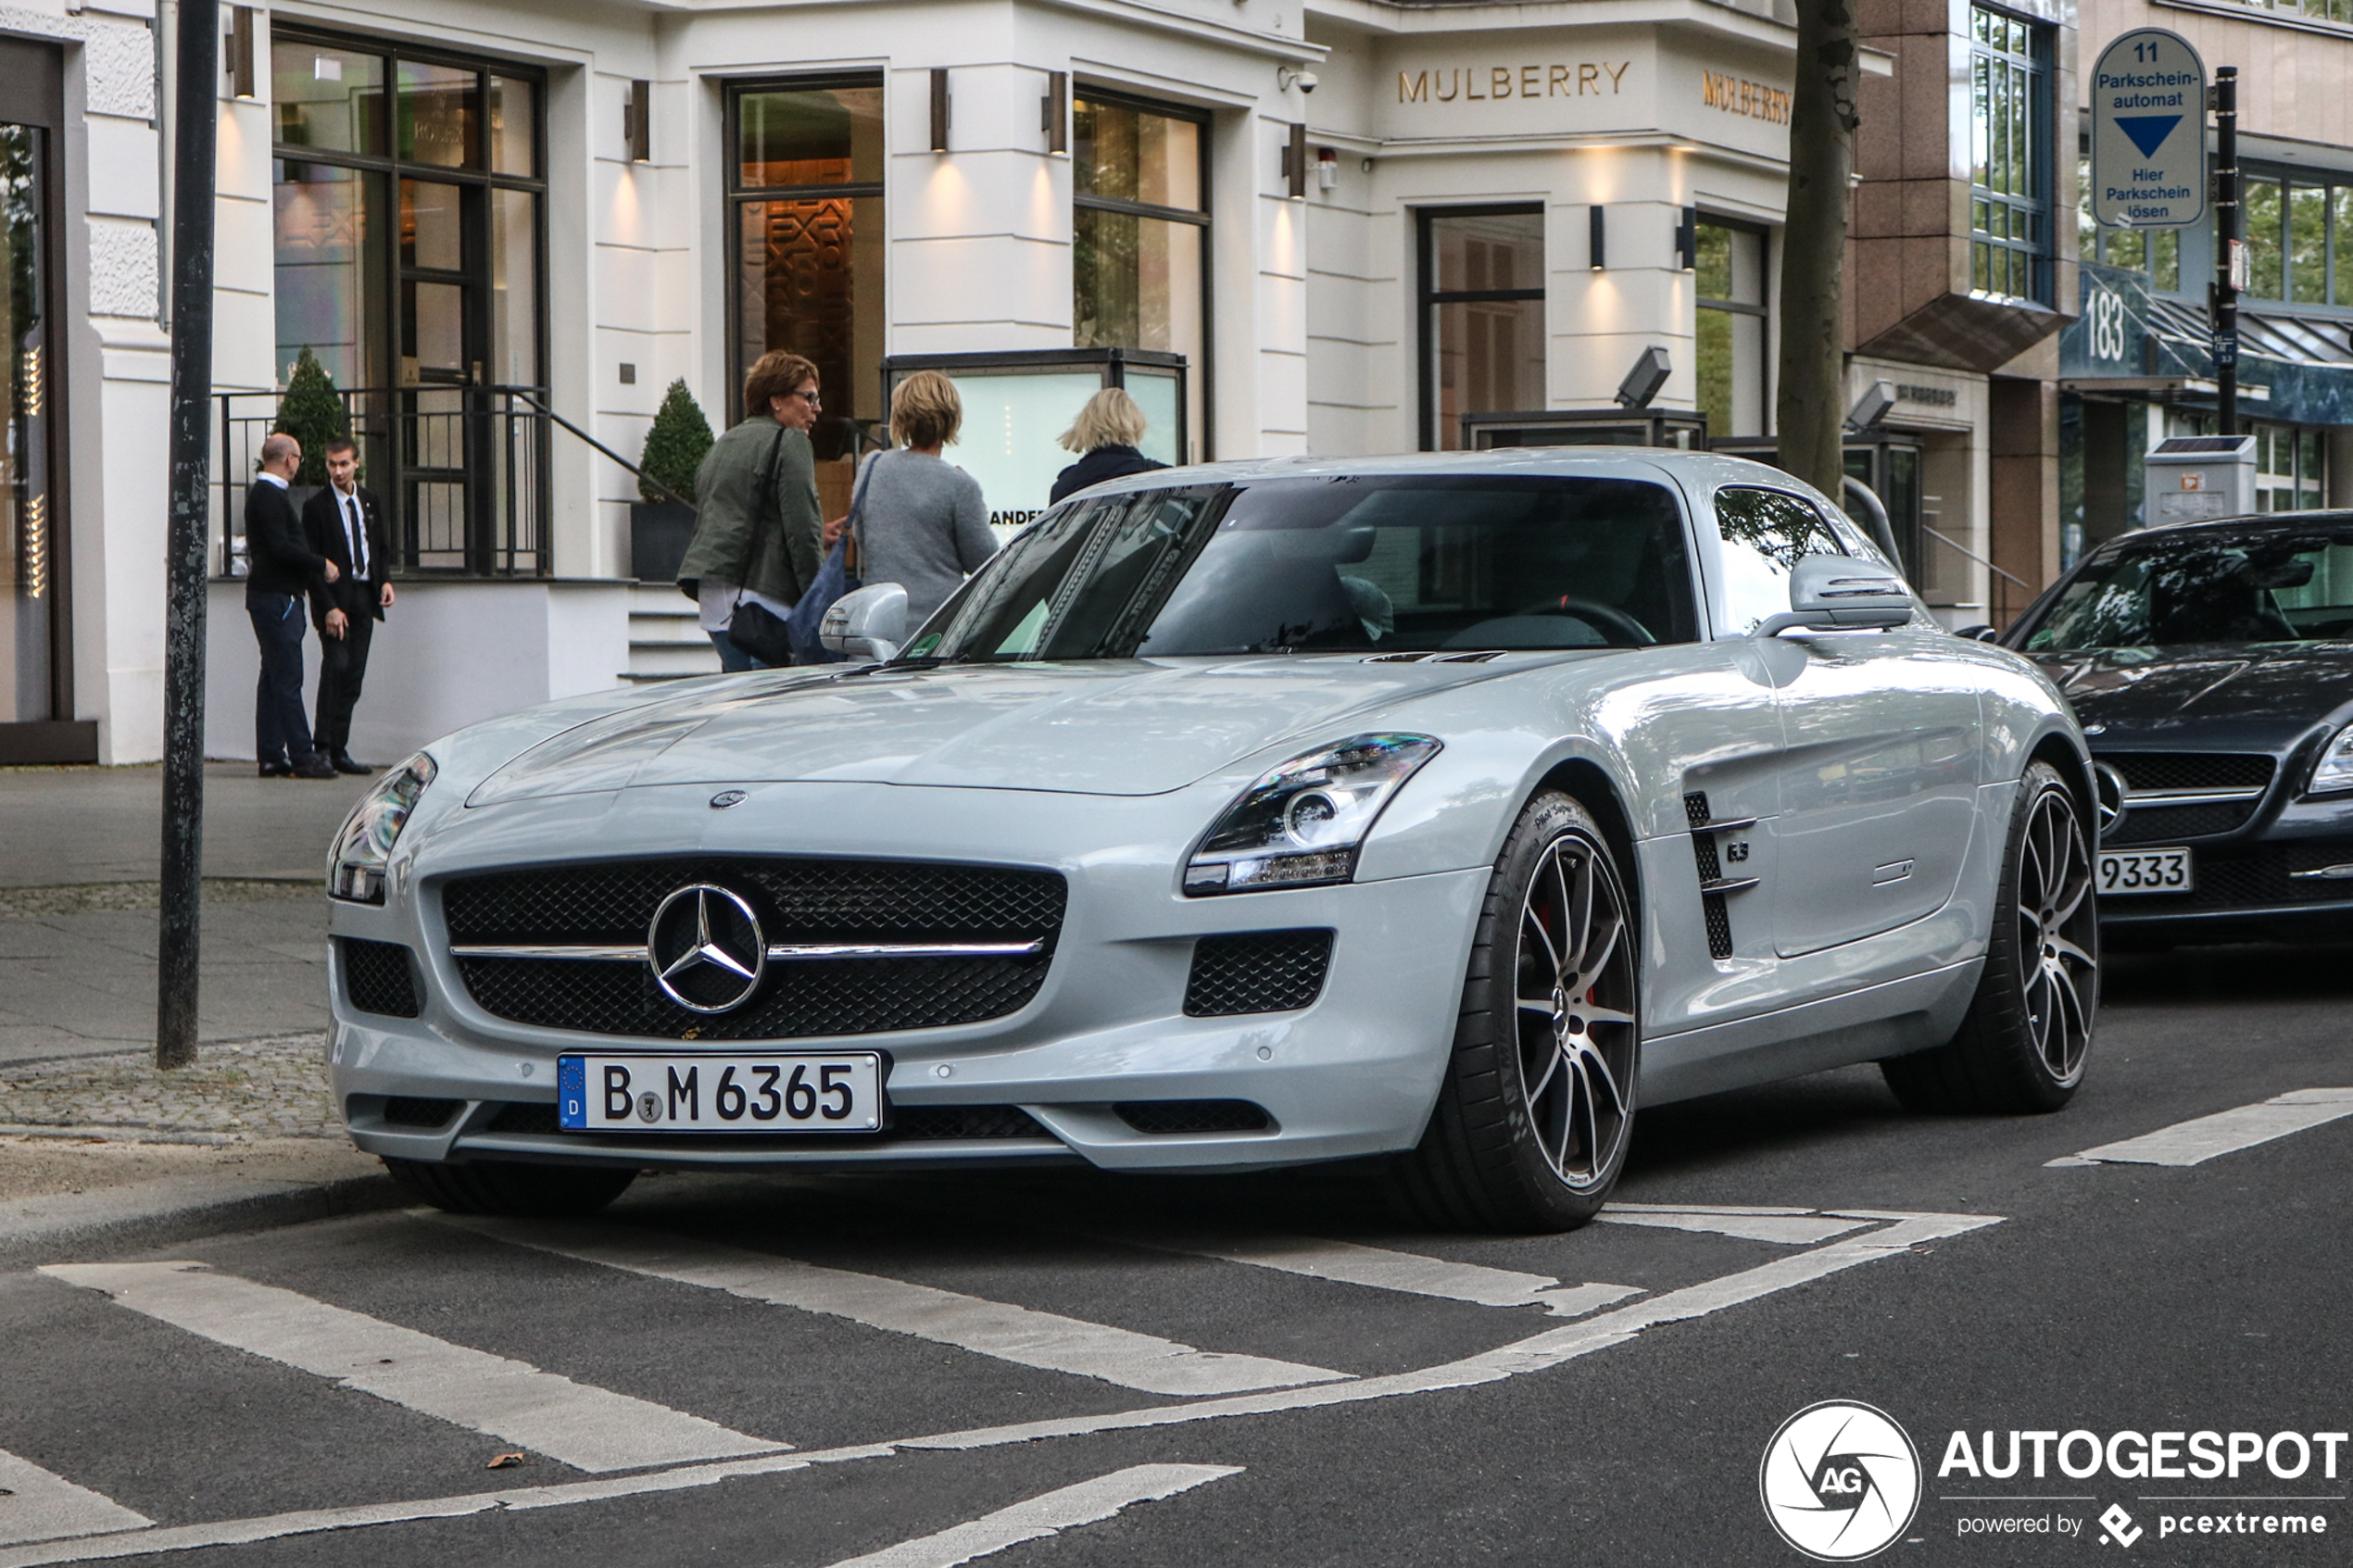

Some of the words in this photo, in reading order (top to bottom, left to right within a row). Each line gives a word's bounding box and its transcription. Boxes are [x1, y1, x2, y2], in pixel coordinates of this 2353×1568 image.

[2133, 42, 2158, 63] 11
[1398, 61, 1630, 104] MULBERRY
[2098, 70, 2198, 88] Parkschein-
[1703, 69, 1793, 126] MULBERRY
[2113, 92, 2183, 108] automat
[2133, 169, 2164, 182] Hier
[2107, 185, 2191, 201] Parkschein
[2128, 205, 2170, 219] lösen
[2085, 288, 2124, 361] 183
[2101, 855, 2184, 889] 9333
[603, 1065, 634, 1120] B
[668, 1065, 698, 1120] M
[716, 1064, 853, 1121] 6365
[568, 1099, 579, 1115] D
